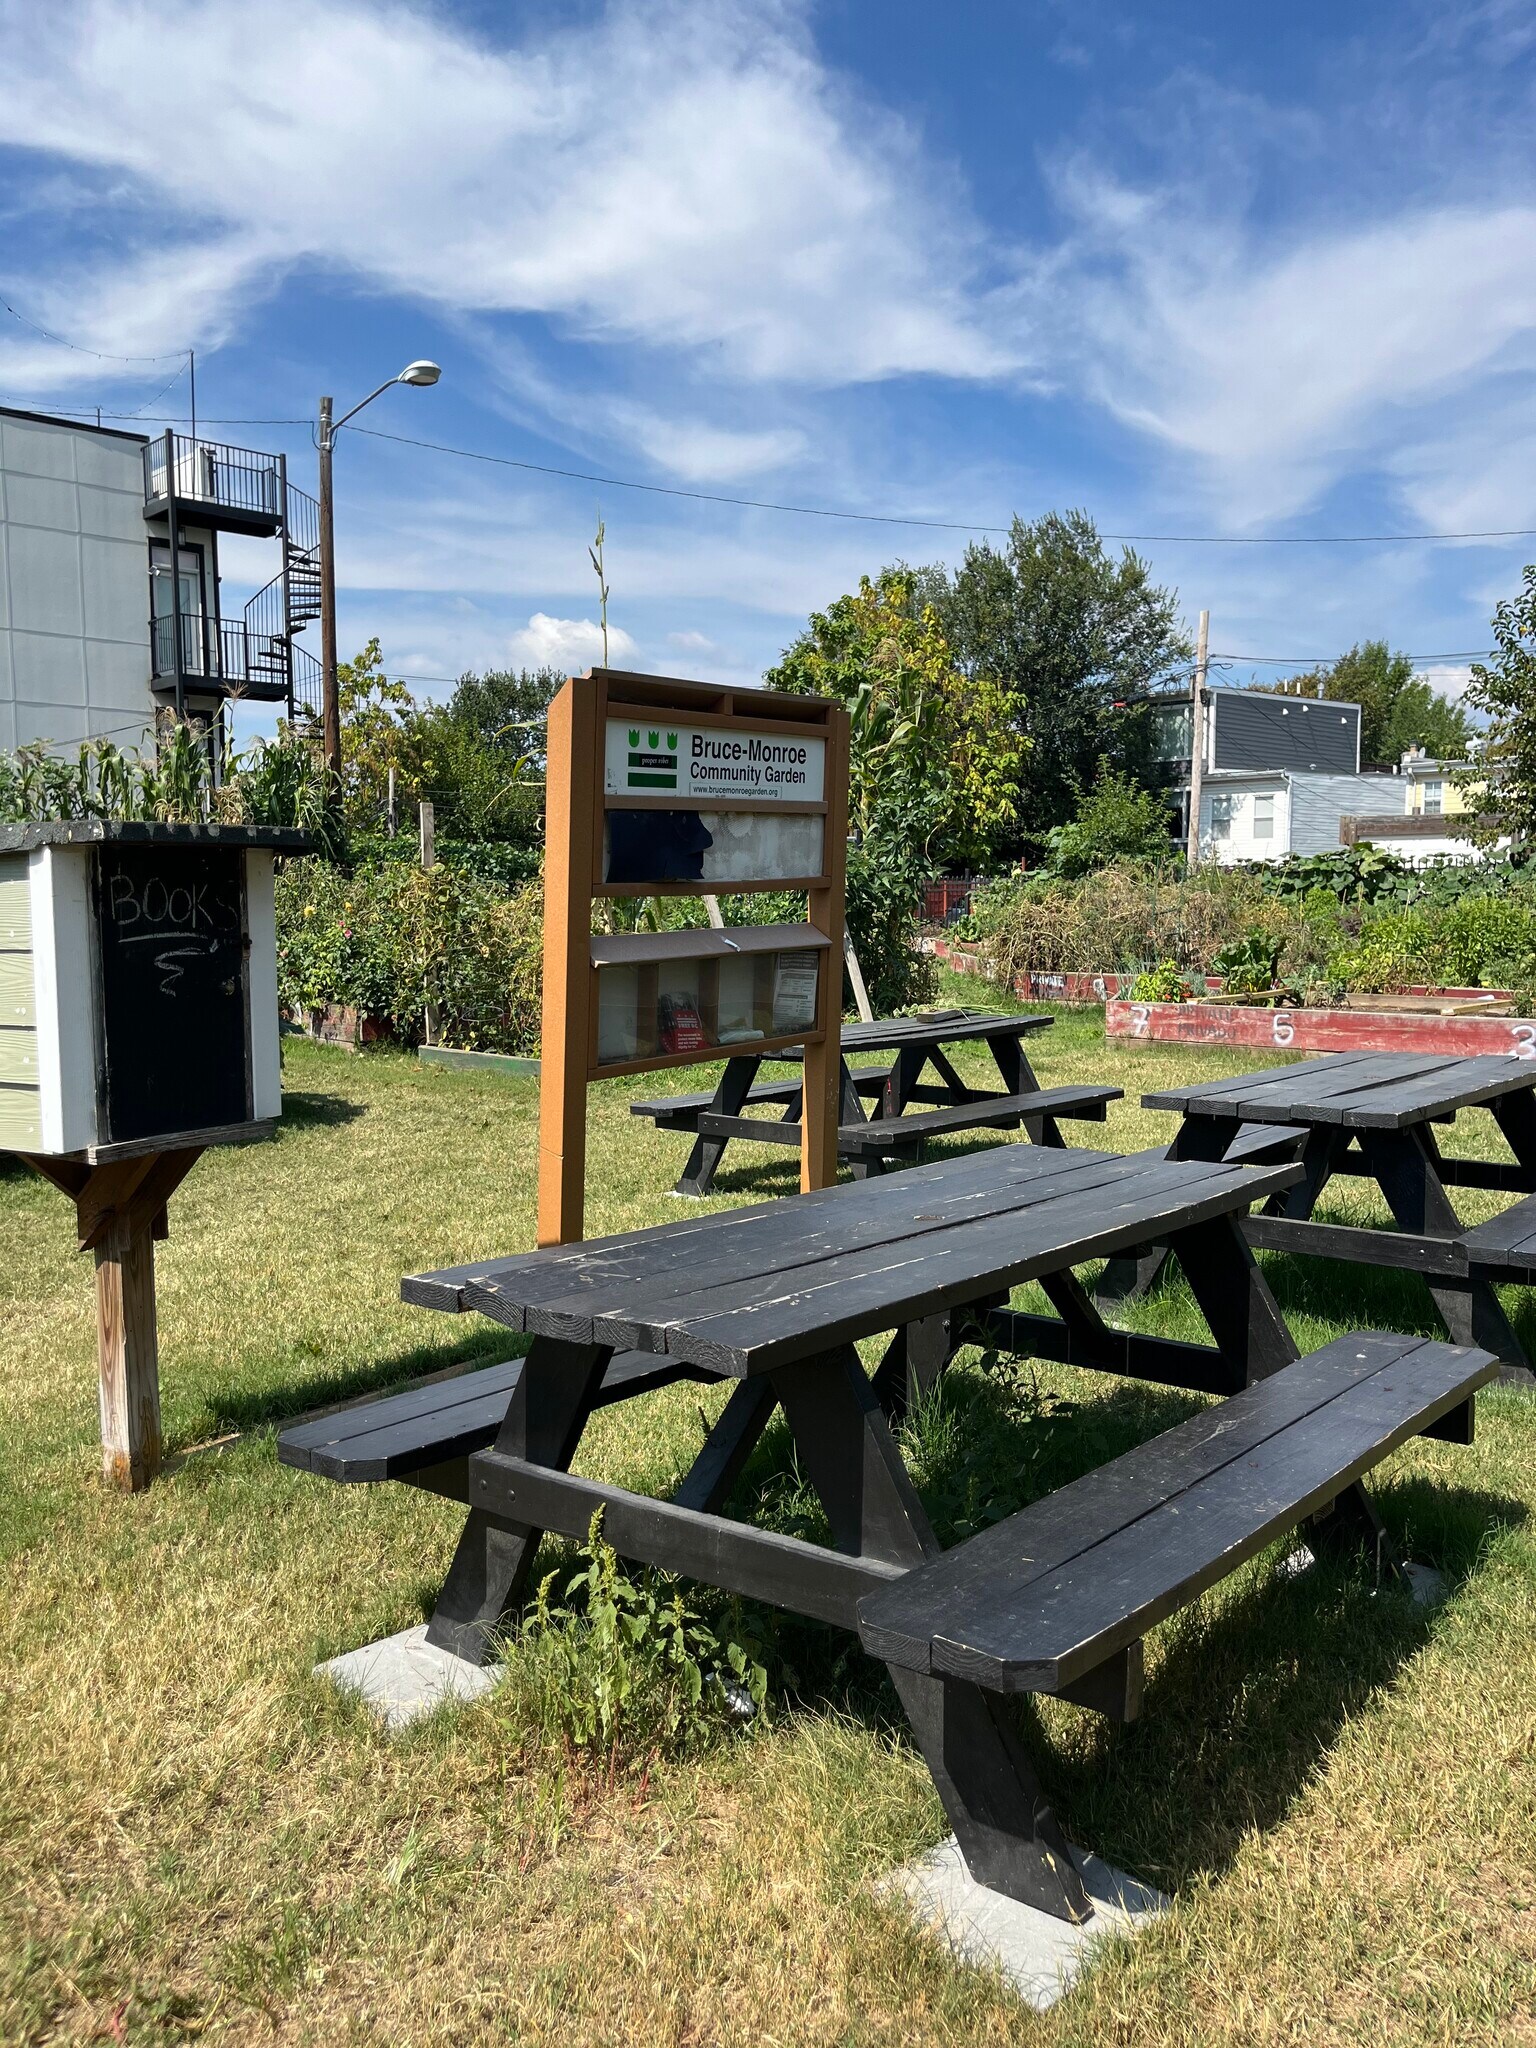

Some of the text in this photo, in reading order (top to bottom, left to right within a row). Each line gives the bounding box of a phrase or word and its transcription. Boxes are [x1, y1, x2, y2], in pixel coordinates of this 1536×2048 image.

[692, 734, 807, 764] Bruce-Monroe
[690, 761, 806, 786] Community Garden
[693, 786, 778, 797] www.brucemonroegarden.org
[110, 873, 239, 931] BOOKS
[1030, 974, 1065, 987] PRIVATE
[1131, 1006, 1151, 1034] 7
[1511, 1024, 1536, 1060] 3
